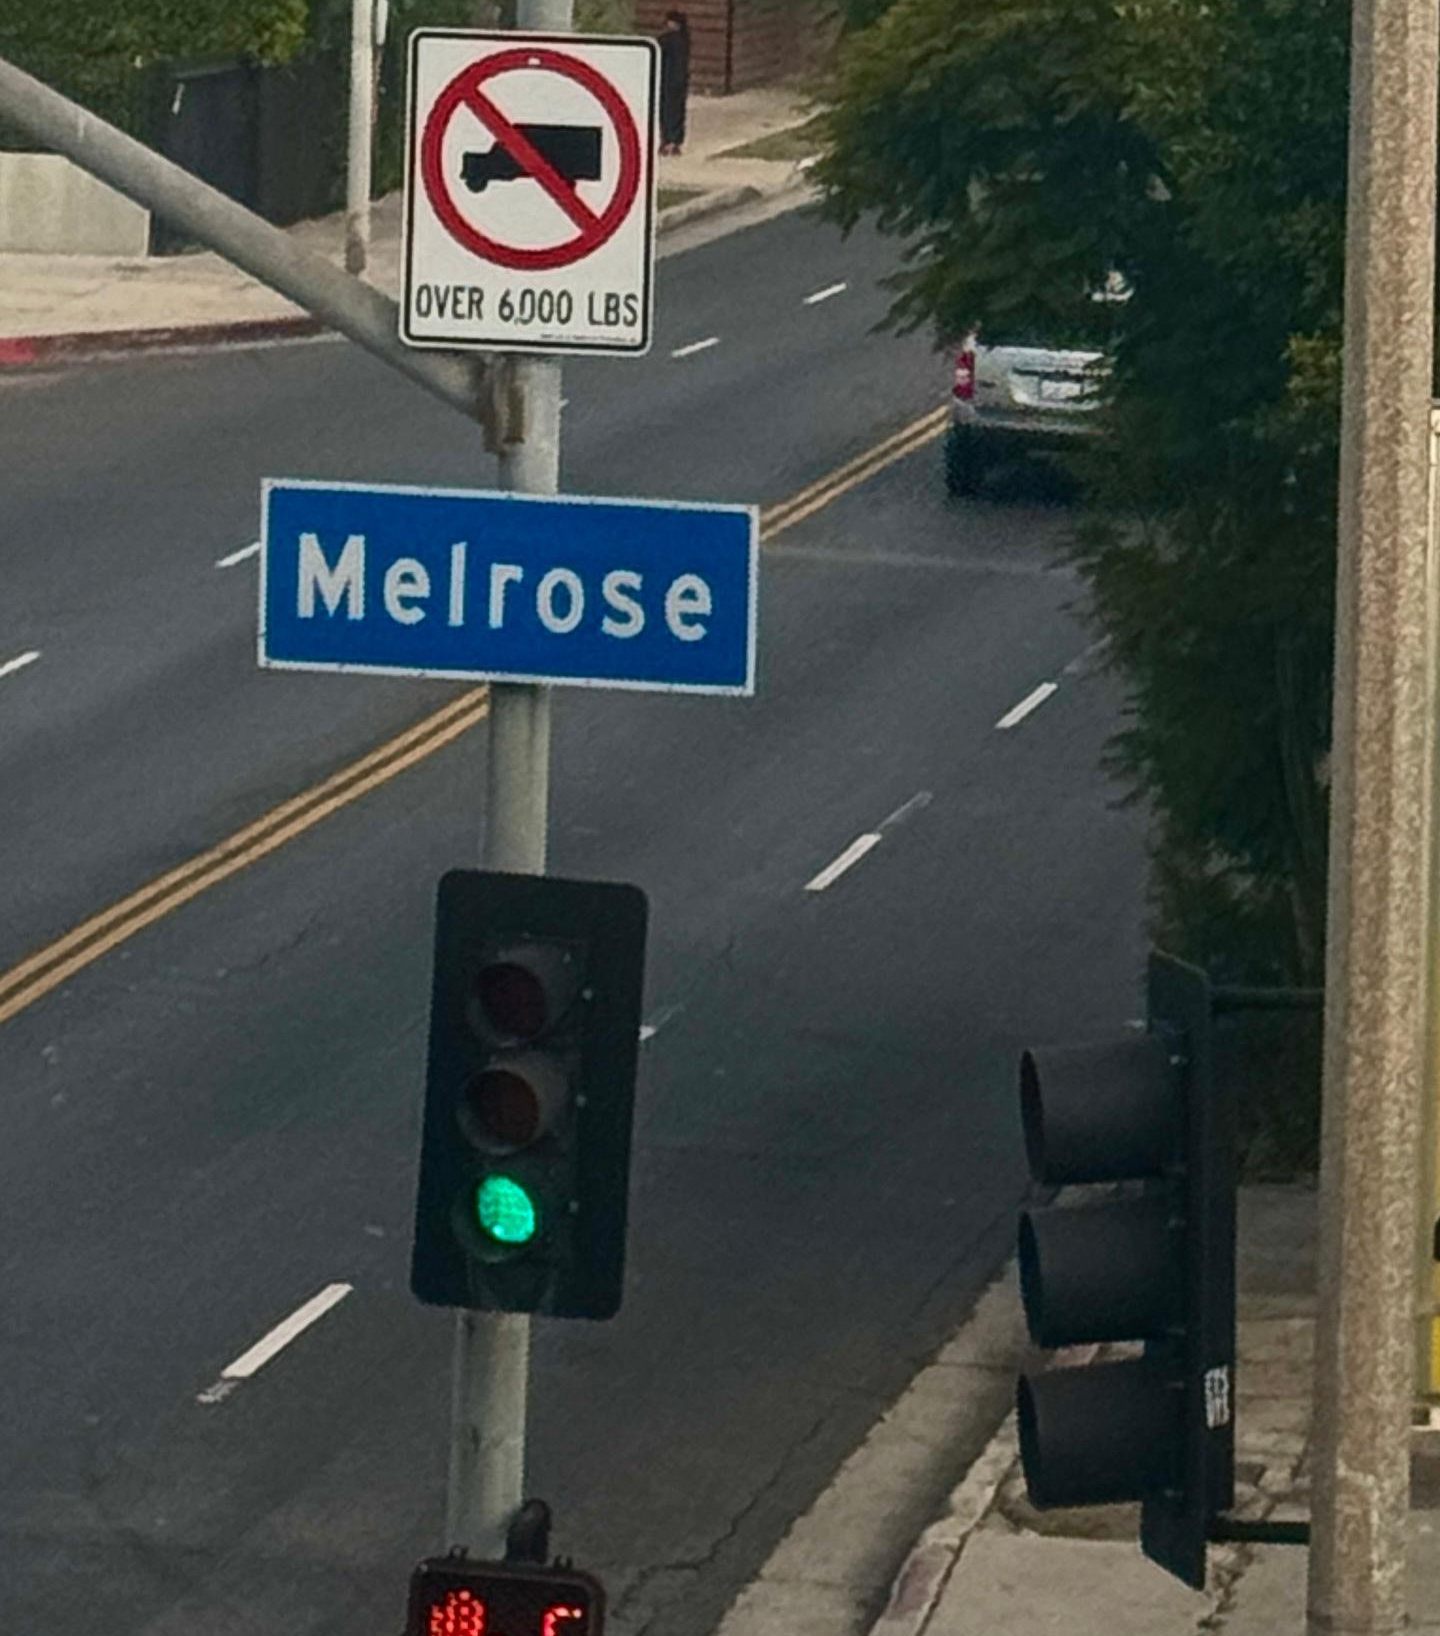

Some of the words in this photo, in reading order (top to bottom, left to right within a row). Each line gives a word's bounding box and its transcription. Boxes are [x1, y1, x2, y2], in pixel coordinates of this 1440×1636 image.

[415, 284, 484, 320] OVER
[588, 291, 639, 327] LBS
[297, 532, 712, 641] Melrose
